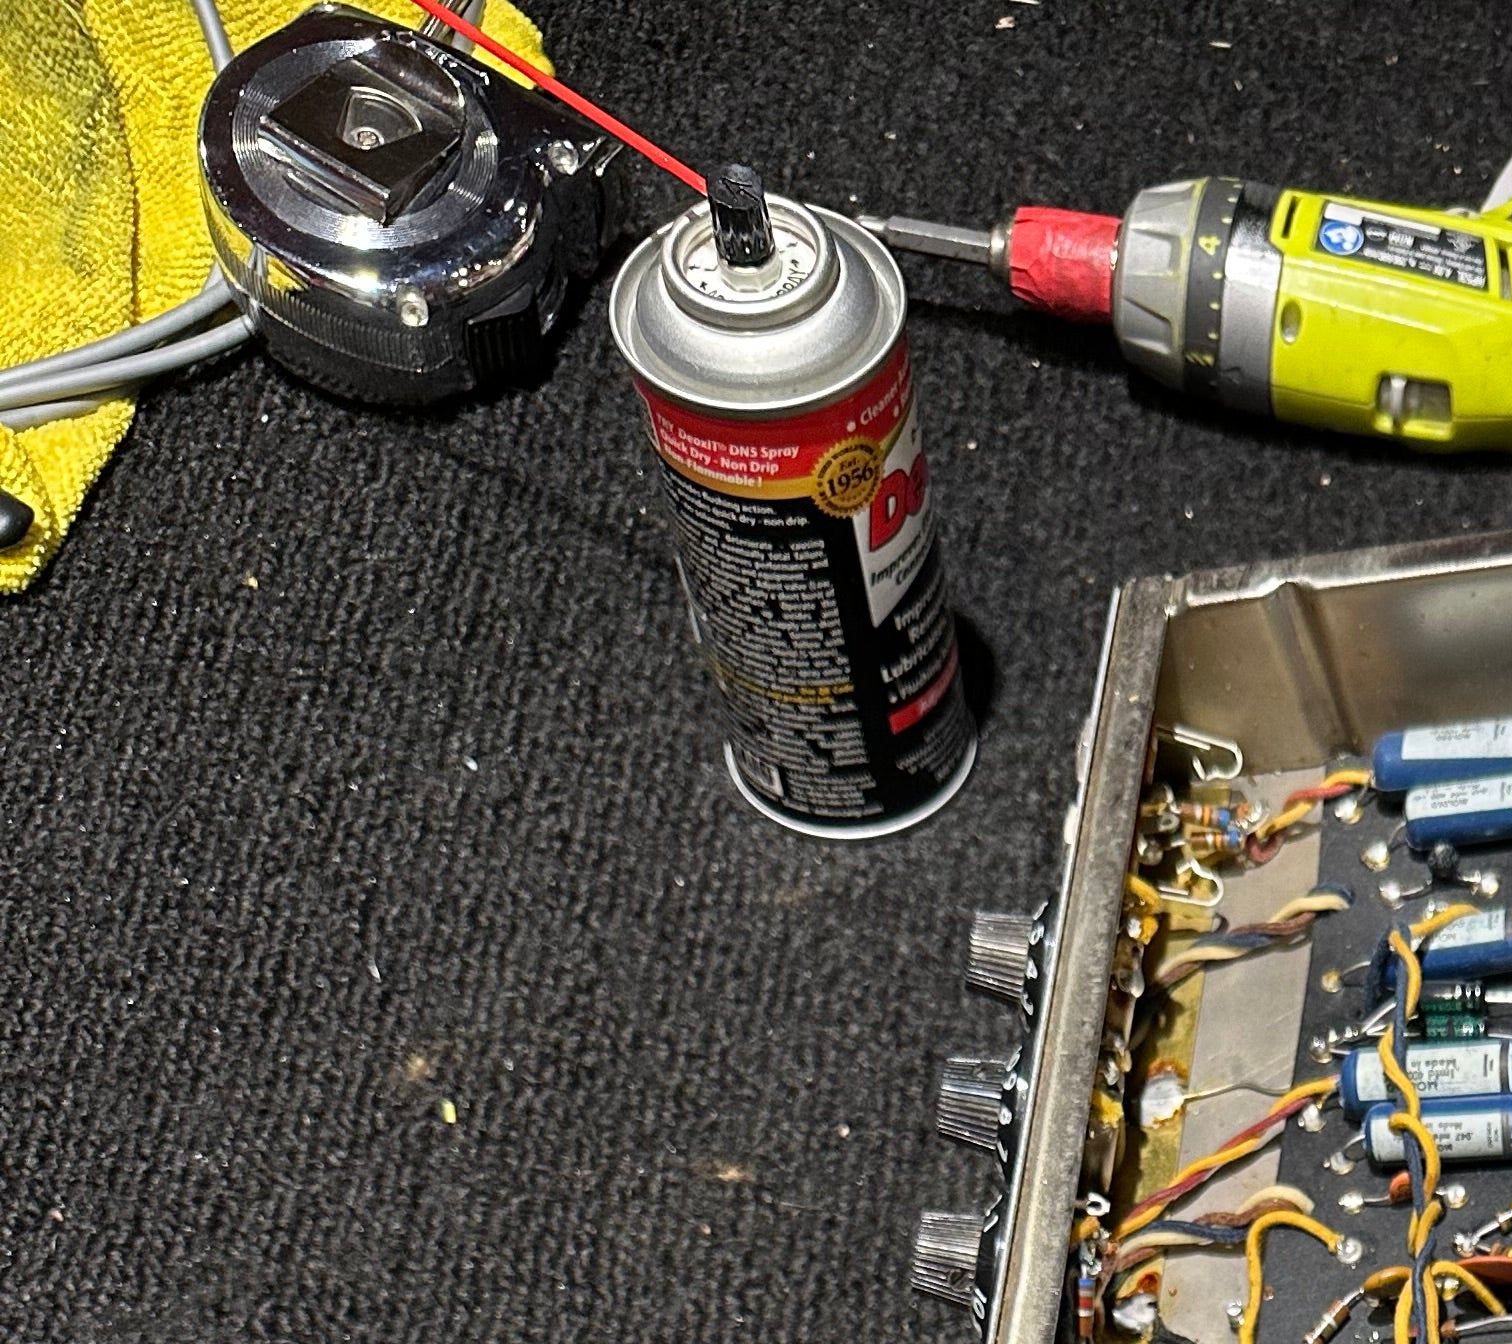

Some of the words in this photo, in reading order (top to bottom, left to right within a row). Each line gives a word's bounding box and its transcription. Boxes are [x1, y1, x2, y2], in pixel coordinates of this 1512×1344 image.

[656, 412, 675, 433] TRY
[761, 445, 800, 460] Spray
[660, 429, 689, 453] Quick
[690, 448, 711, 465] Dry
[720, 457, 747, 473] Non
[750, 461, 779, 475] Drip
[826, 463, 874, 498] 1956
[739, 514, 756, 527] dry
[763, 518, 785, 528] non
